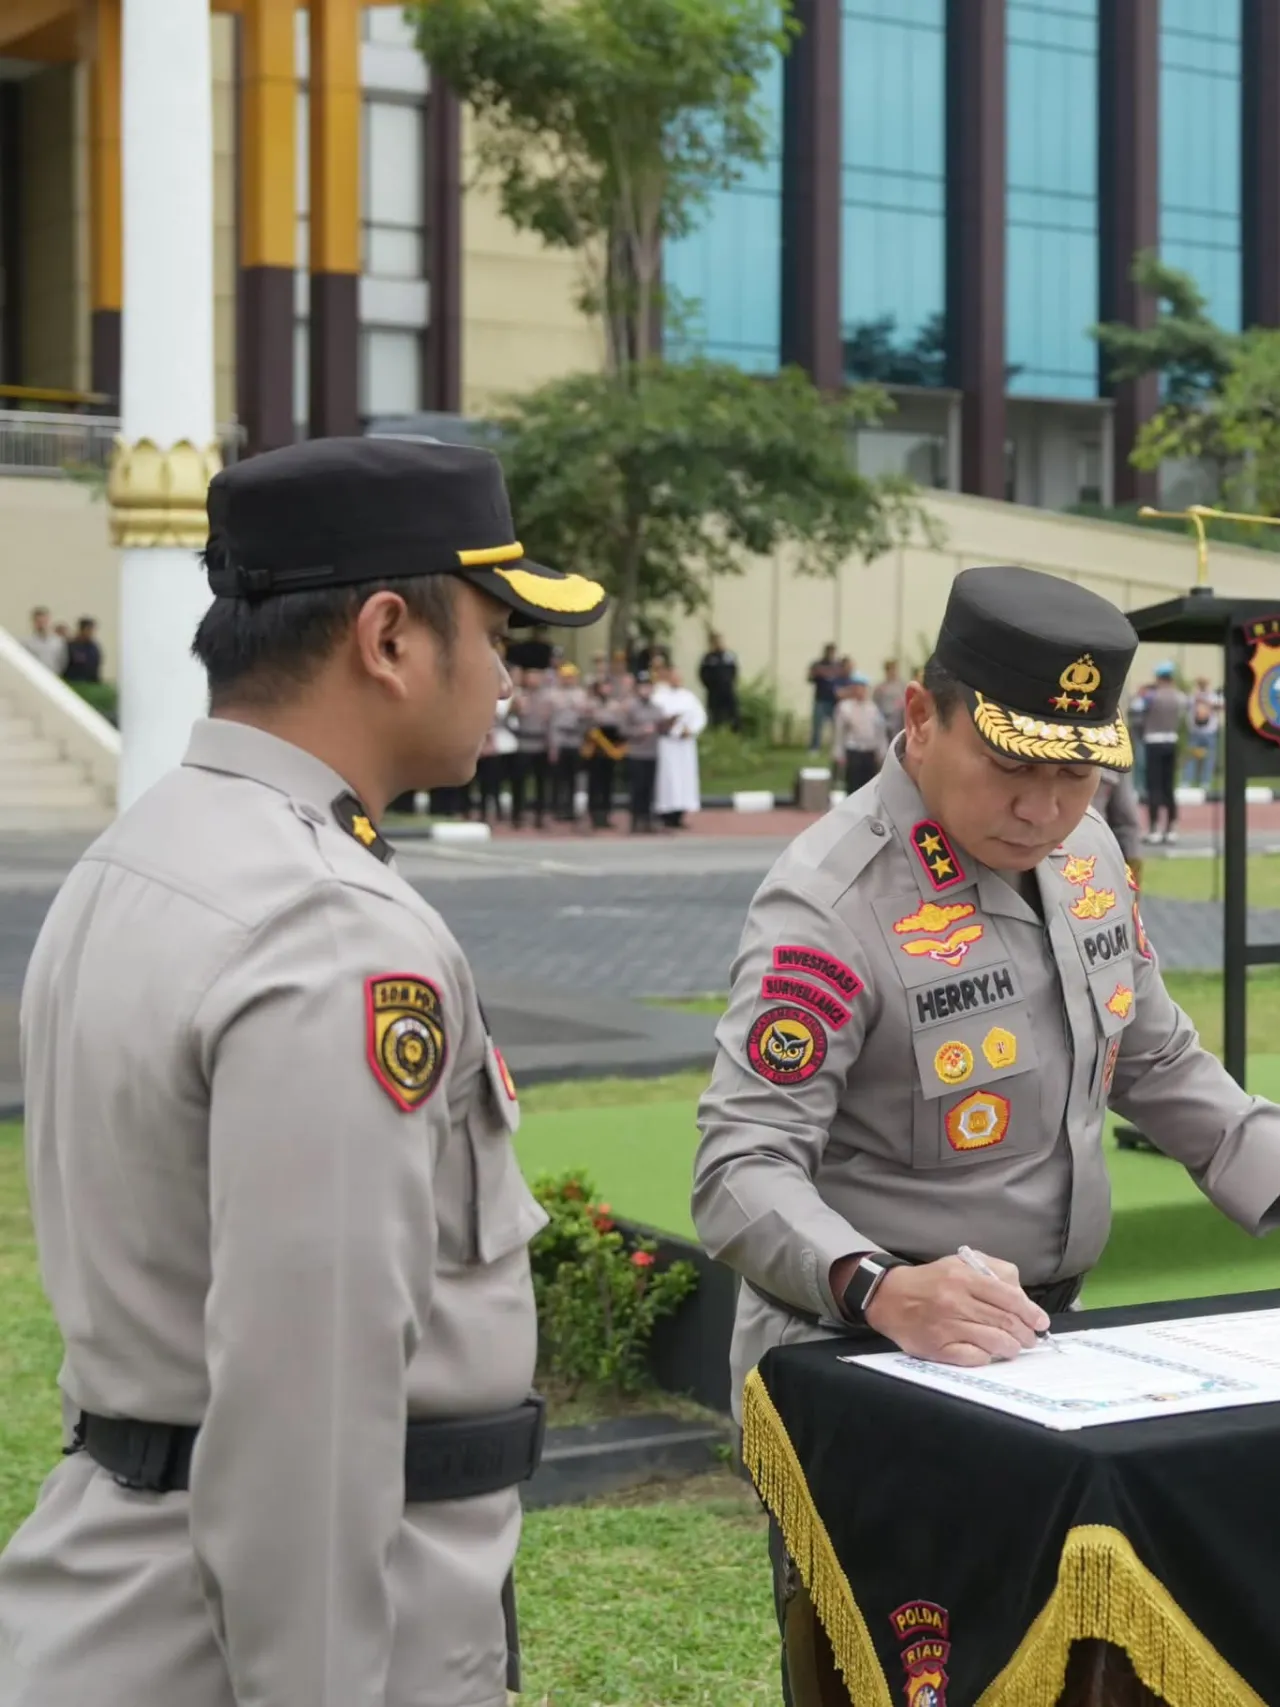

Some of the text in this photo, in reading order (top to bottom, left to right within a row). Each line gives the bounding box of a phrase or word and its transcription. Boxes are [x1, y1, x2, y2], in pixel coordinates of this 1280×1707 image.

[1084, 922, 1129, 965] POLRI
[777, 949, 858, 994] INVESTIGASI
[766, 980, 846, 1024] SURVEILLANCE
[915, 968, 1015, 1023] HERRY.H
[896, 1607, 943, 1632] POLDA
[906, 1644, 943, 1665] RIAU
